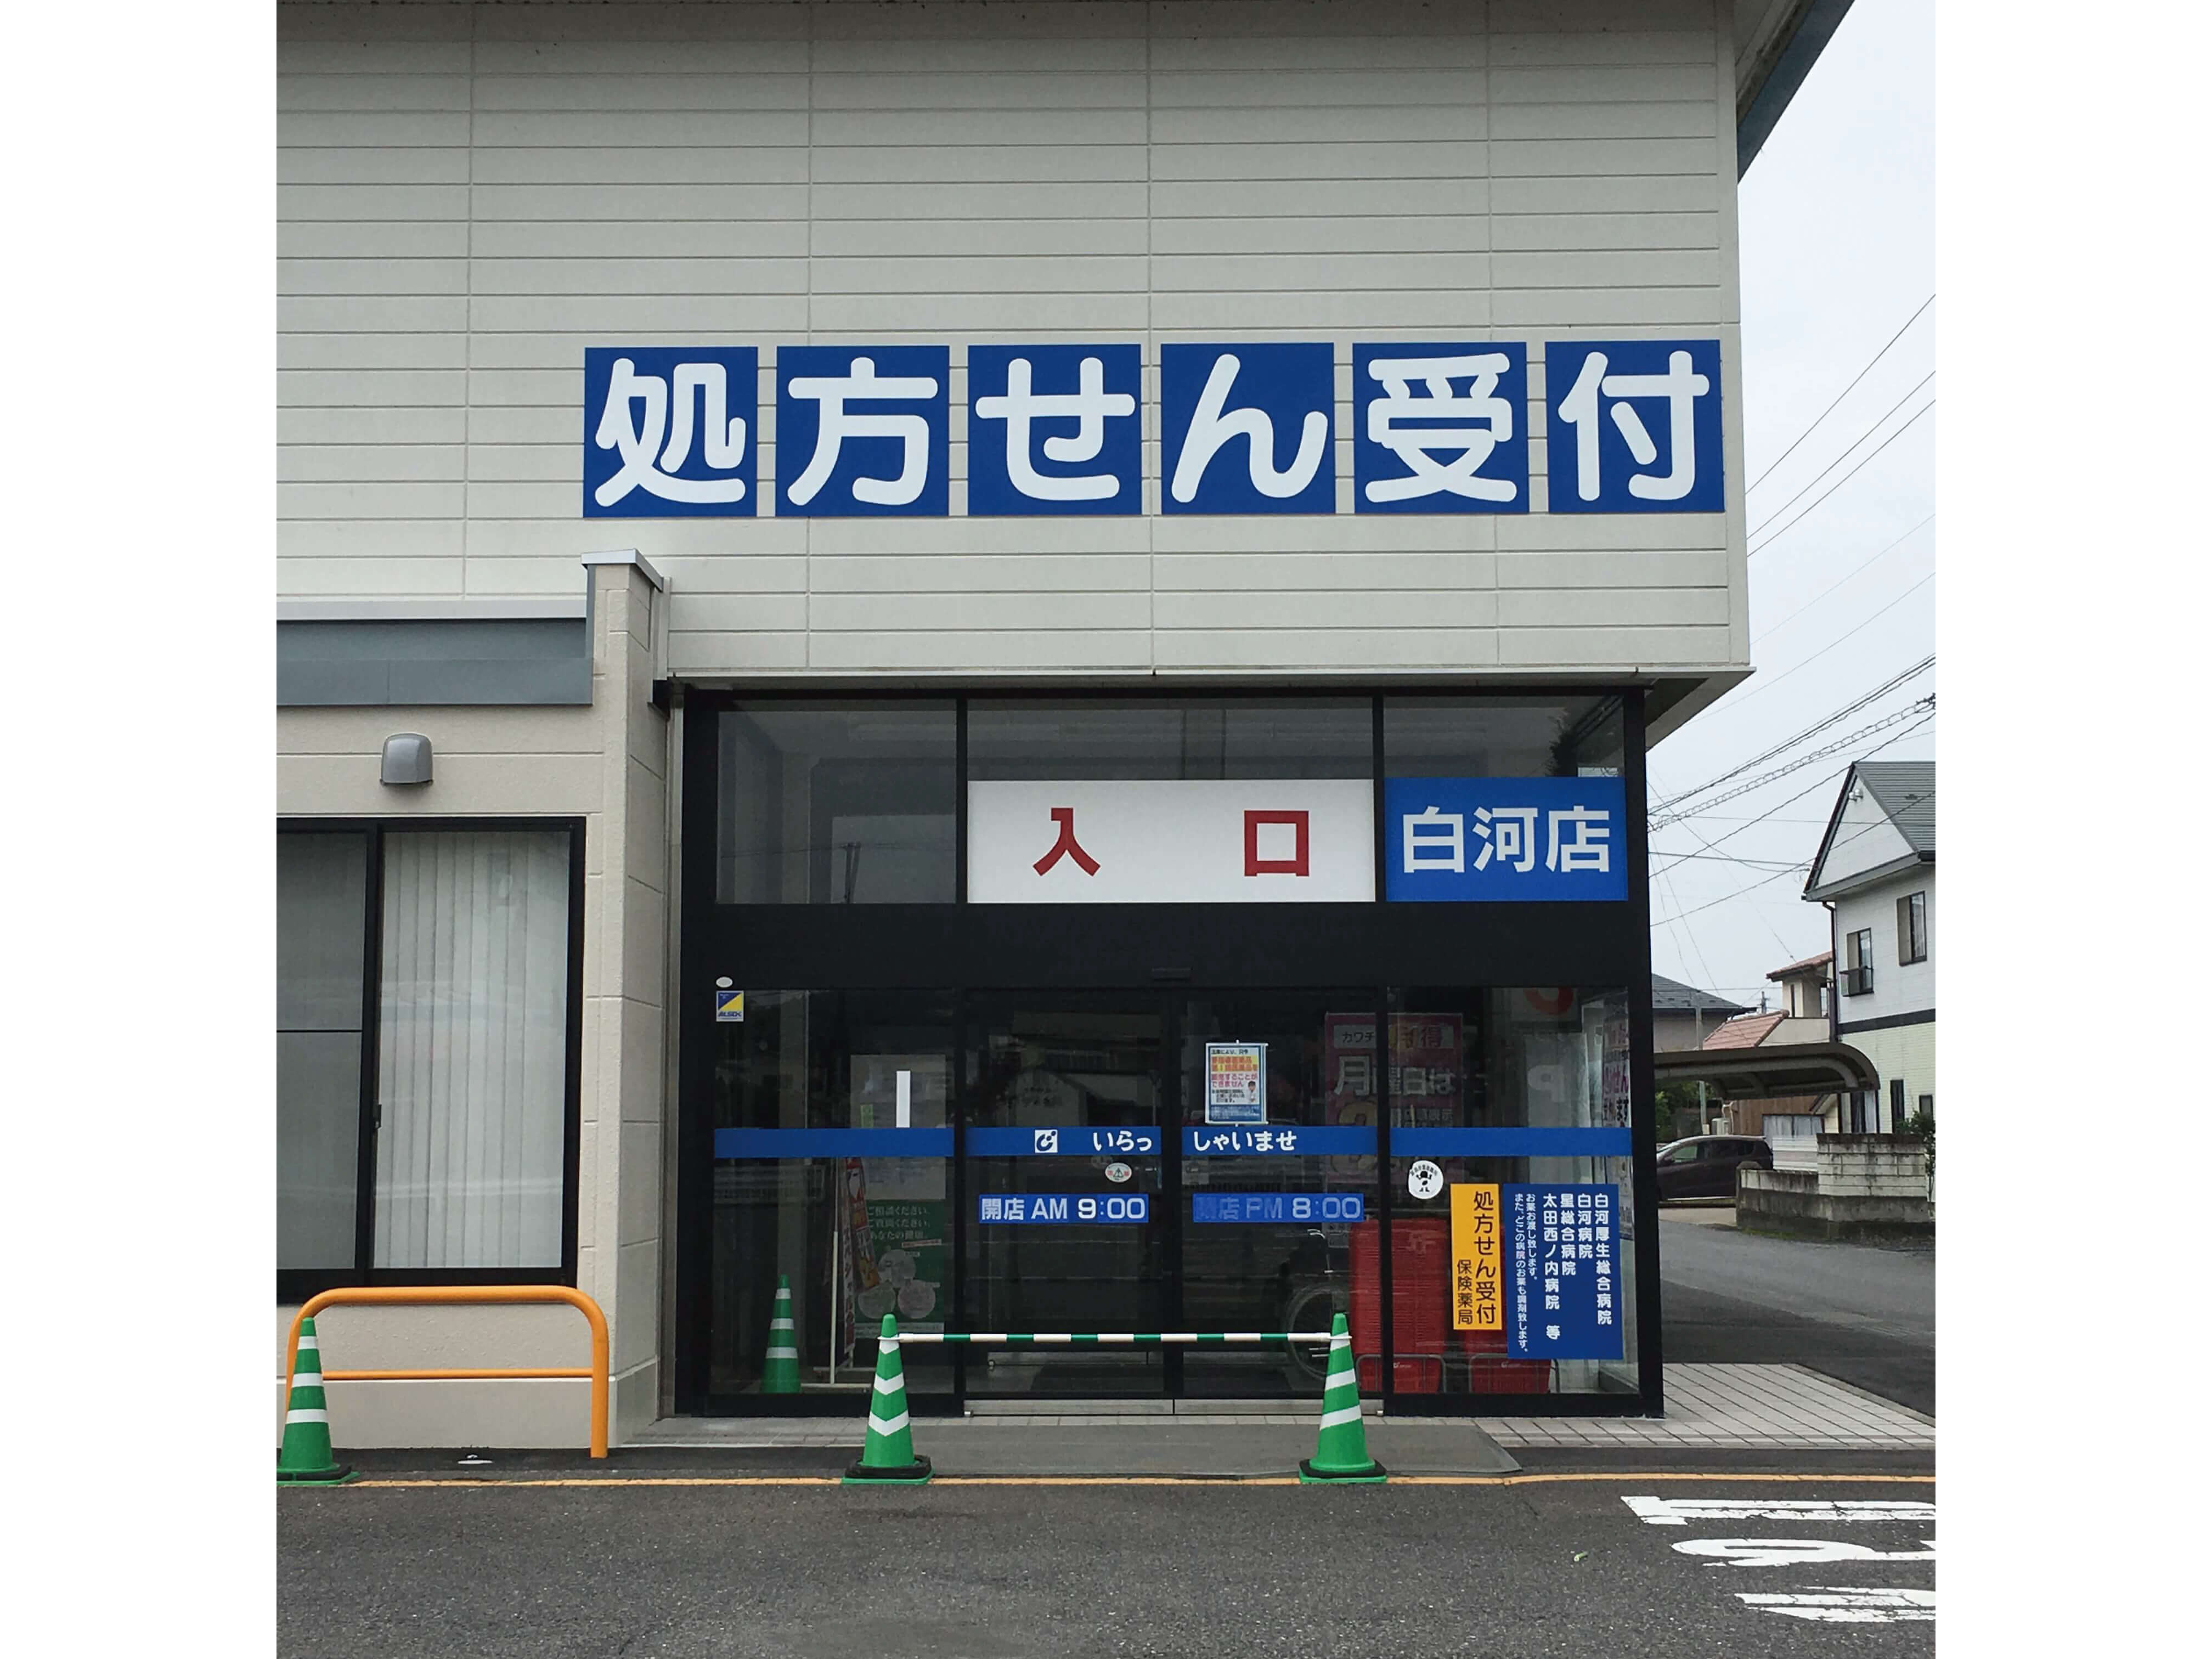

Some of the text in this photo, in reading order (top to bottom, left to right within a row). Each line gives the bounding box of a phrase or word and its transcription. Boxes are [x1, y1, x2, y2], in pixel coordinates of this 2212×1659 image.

[595, 351, 1709, 506] 処方せん受付
[1402, 805, 1611, 873] 白河店
[1093, 1131, 1297, 1152] いらっ しゃいませ
[981, 1198, 1146, 1221] 開店 AM 9:00
[1246, 1198, 1283, 1219] PM
[1293, 1198, 1361, 1219] 8:00
[1560, 1193, 1576, 1276] 星総合病院
[1577, 1193, 1593, 1259] 白河病院
[1474, 1191, 1497, 1324] 処方せん受付
[1543, 1193, 1560, 1310] 太田西ノ内病院
[1595, 1193, 1613, 1325] 白河厚生総合病院
[1457, 1259, 1473, 1325] 保険薬局
